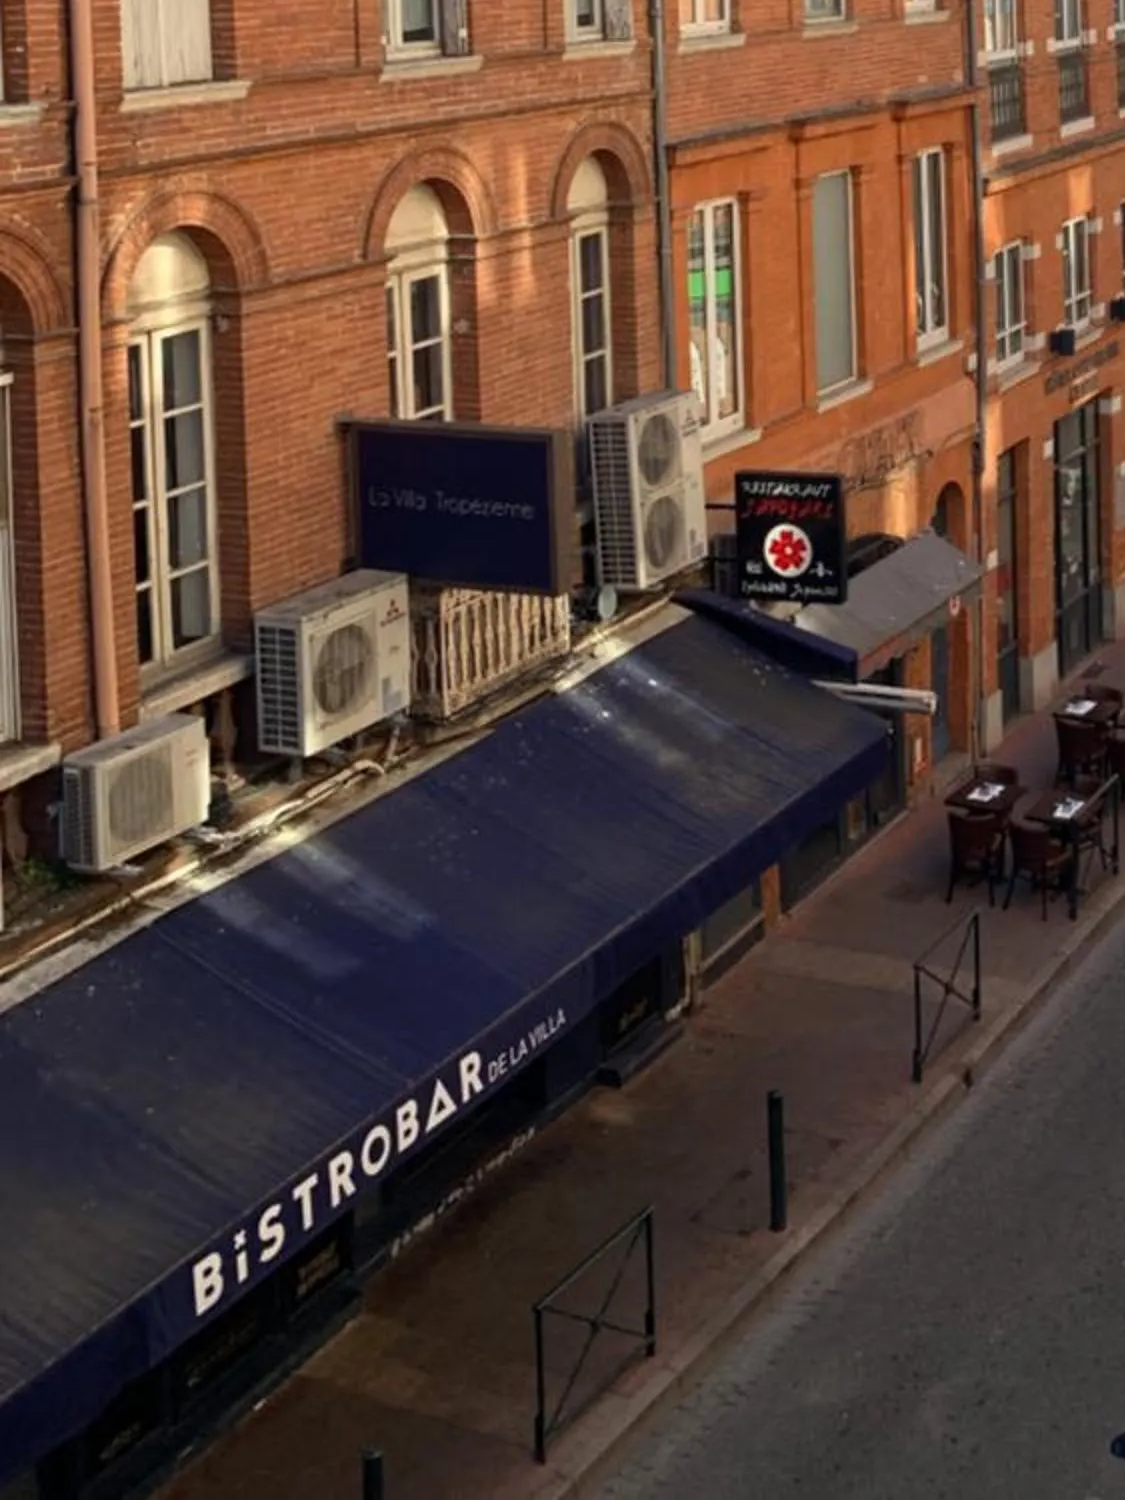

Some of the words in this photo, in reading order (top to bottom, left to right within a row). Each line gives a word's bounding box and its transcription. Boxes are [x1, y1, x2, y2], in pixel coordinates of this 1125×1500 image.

[488, 1052, 508, 1083] DE
[509, 1038, 528, 1066] LA
[528, 1008, 567, 1049] VILLA
